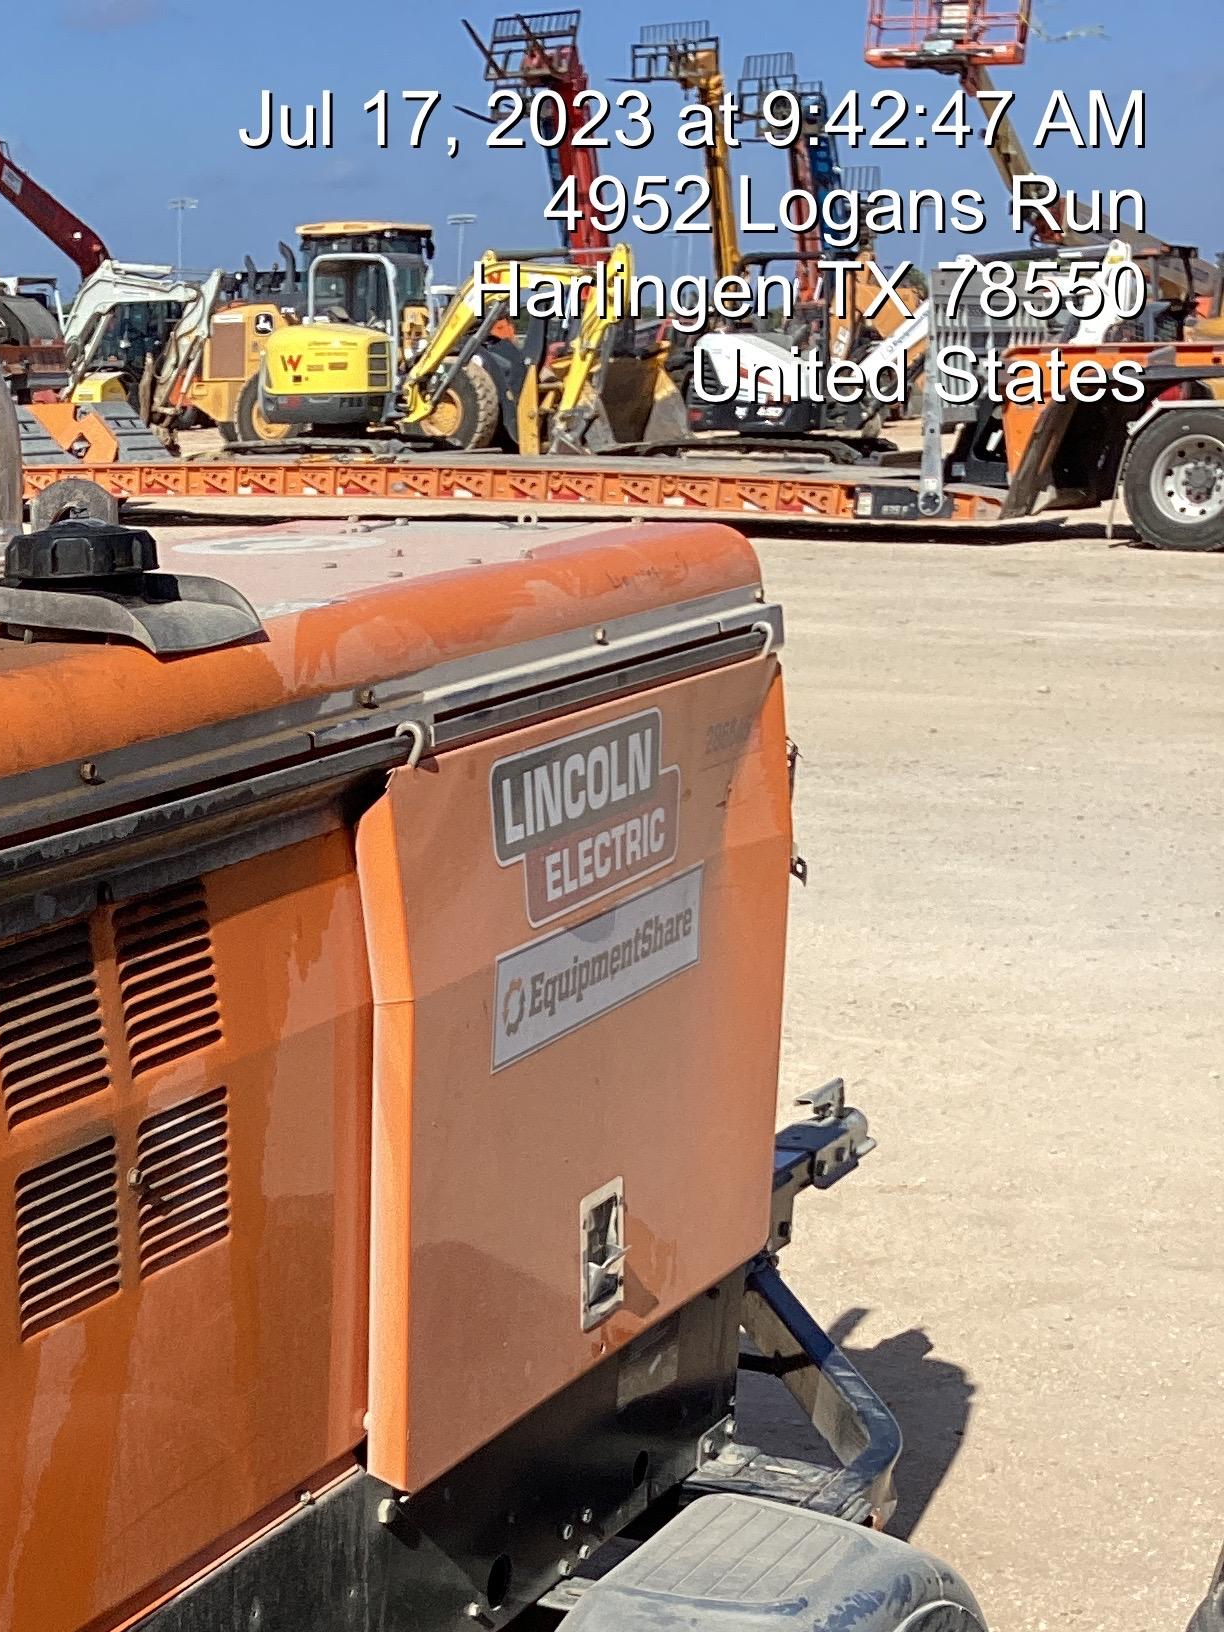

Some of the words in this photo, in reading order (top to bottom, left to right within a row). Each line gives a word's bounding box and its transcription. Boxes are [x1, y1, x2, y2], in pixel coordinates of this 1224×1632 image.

[501, 728, 653, 845] LINCOLN
[545, 806, 666, 902] ELECTRIC
[528, 906, 693, 1016] EquipmentShare
